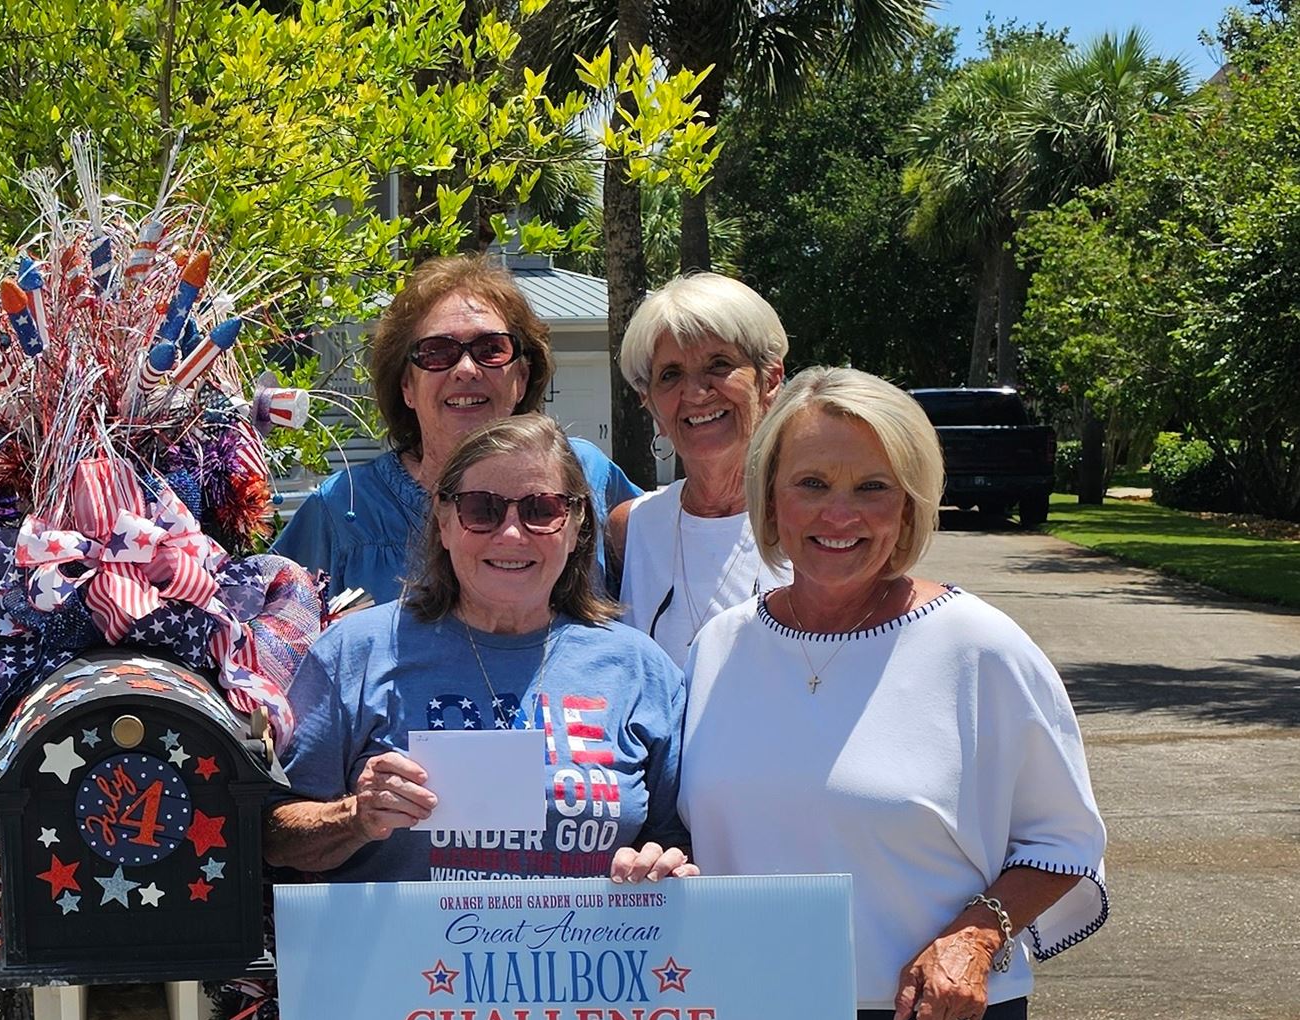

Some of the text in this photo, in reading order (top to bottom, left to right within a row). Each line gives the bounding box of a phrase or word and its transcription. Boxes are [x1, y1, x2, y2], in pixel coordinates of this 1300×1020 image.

[120, 780, 165, 847] 4
[556, 819, 618, 852] GOD
[440, 893, 667, 910] ORANGE BEACH GARDEN CLUB PRESENTS:
[445, 910, 662, 950] Great American
[462, 950, 651, 1003] MAILBOX
